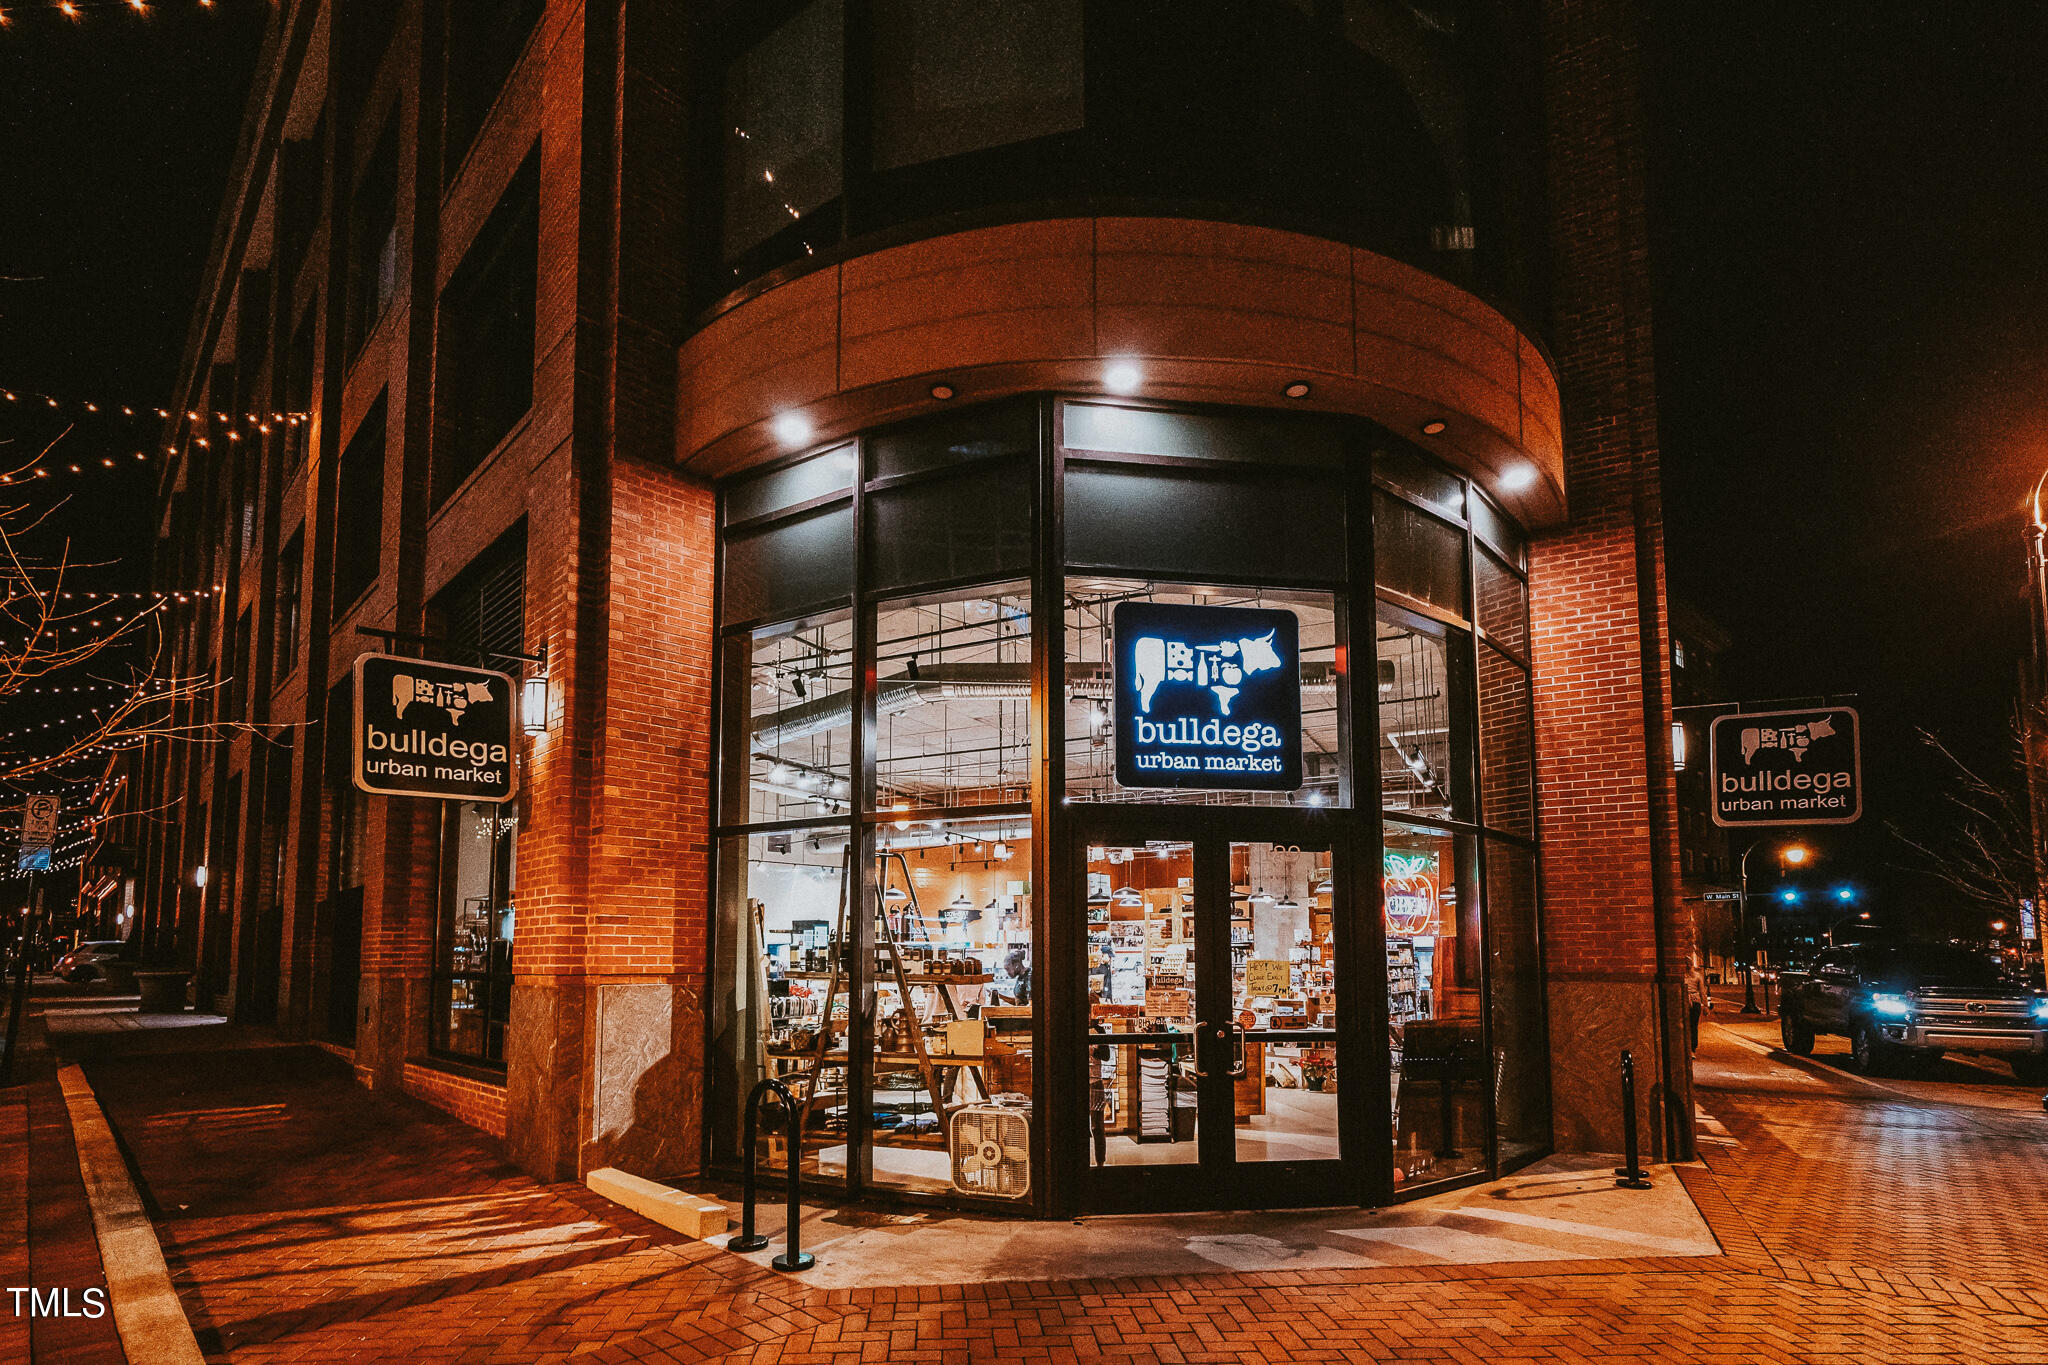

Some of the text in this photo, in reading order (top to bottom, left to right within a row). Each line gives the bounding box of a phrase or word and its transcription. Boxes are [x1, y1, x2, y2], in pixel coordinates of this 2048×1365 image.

[368, 724, 507, 767] bulldega
[1135, 716, 1282, 752] bulldega
[366, 758, 502, 784] urban market
[1135, 752, 1282, 772] urban market
[1722, 770, 1851, 794] bulldega
[1721, 795, 1846, 812] urban market
